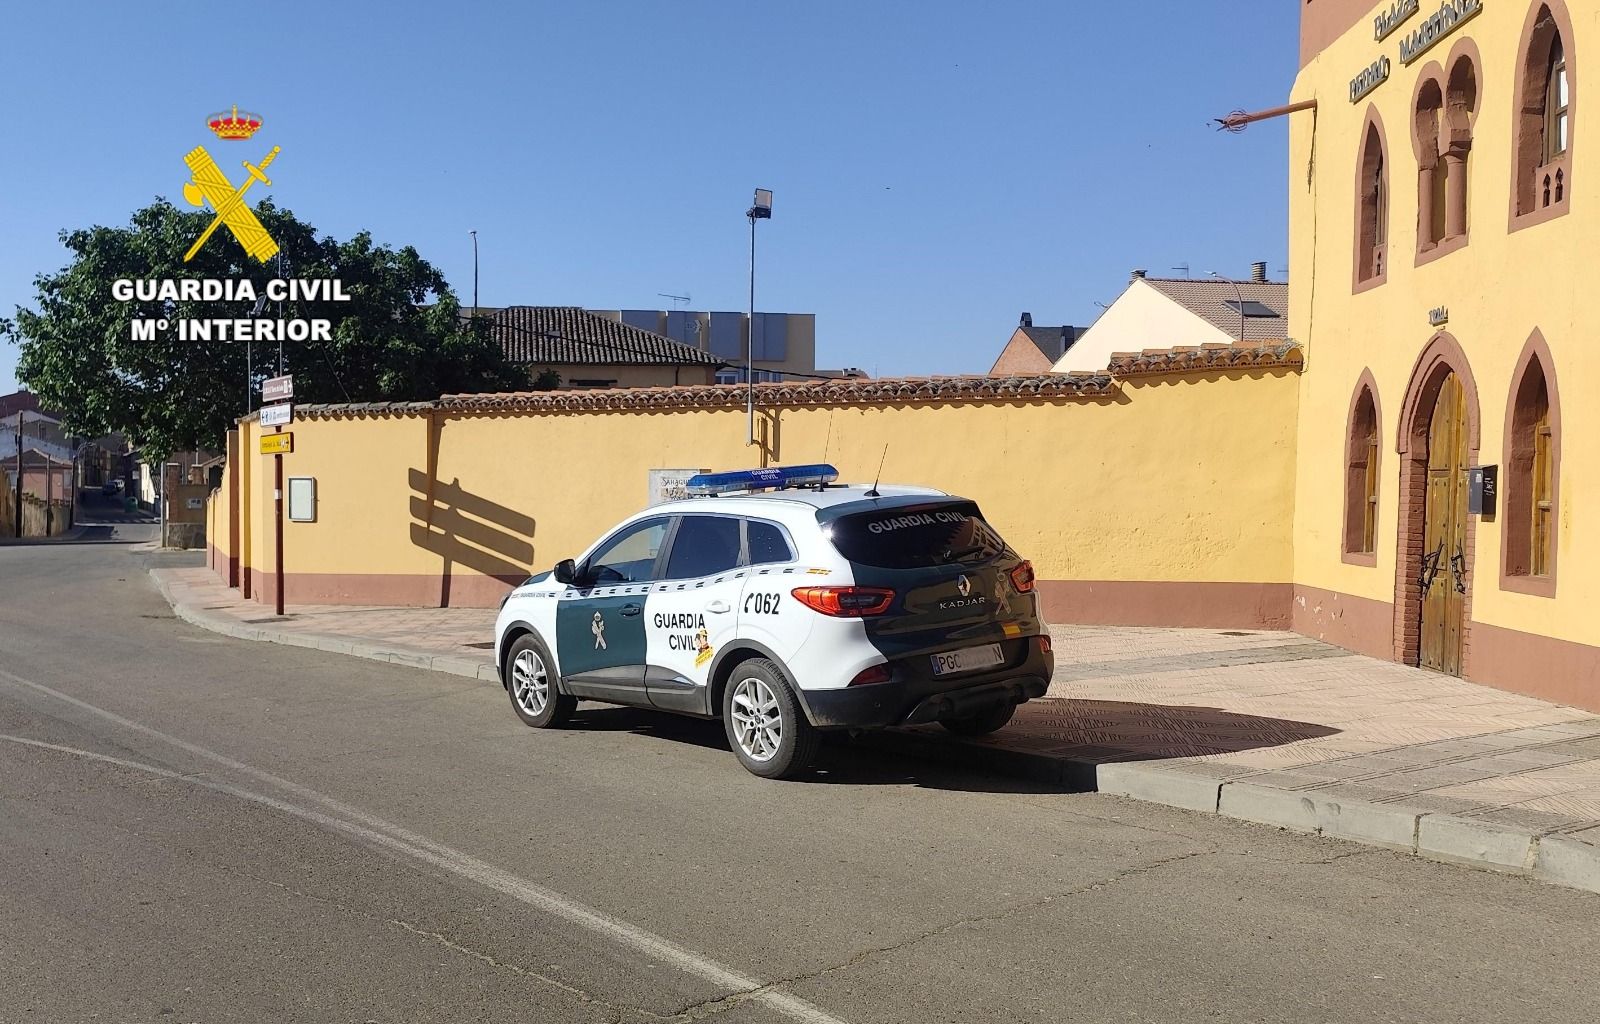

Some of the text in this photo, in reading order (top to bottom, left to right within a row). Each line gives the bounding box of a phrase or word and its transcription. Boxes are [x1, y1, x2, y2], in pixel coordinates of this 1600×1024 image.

[1349, 54, 1388, 102] PEDRO
[868, 512, 969, 534] GUARDIA CIVIL
[754, 592, 781, 615] 062
[940, 597, 985, 609] KADJAR
[654, 613, 706, 629] GUARDIA
[669, 635, 696, 651] CIVIL
